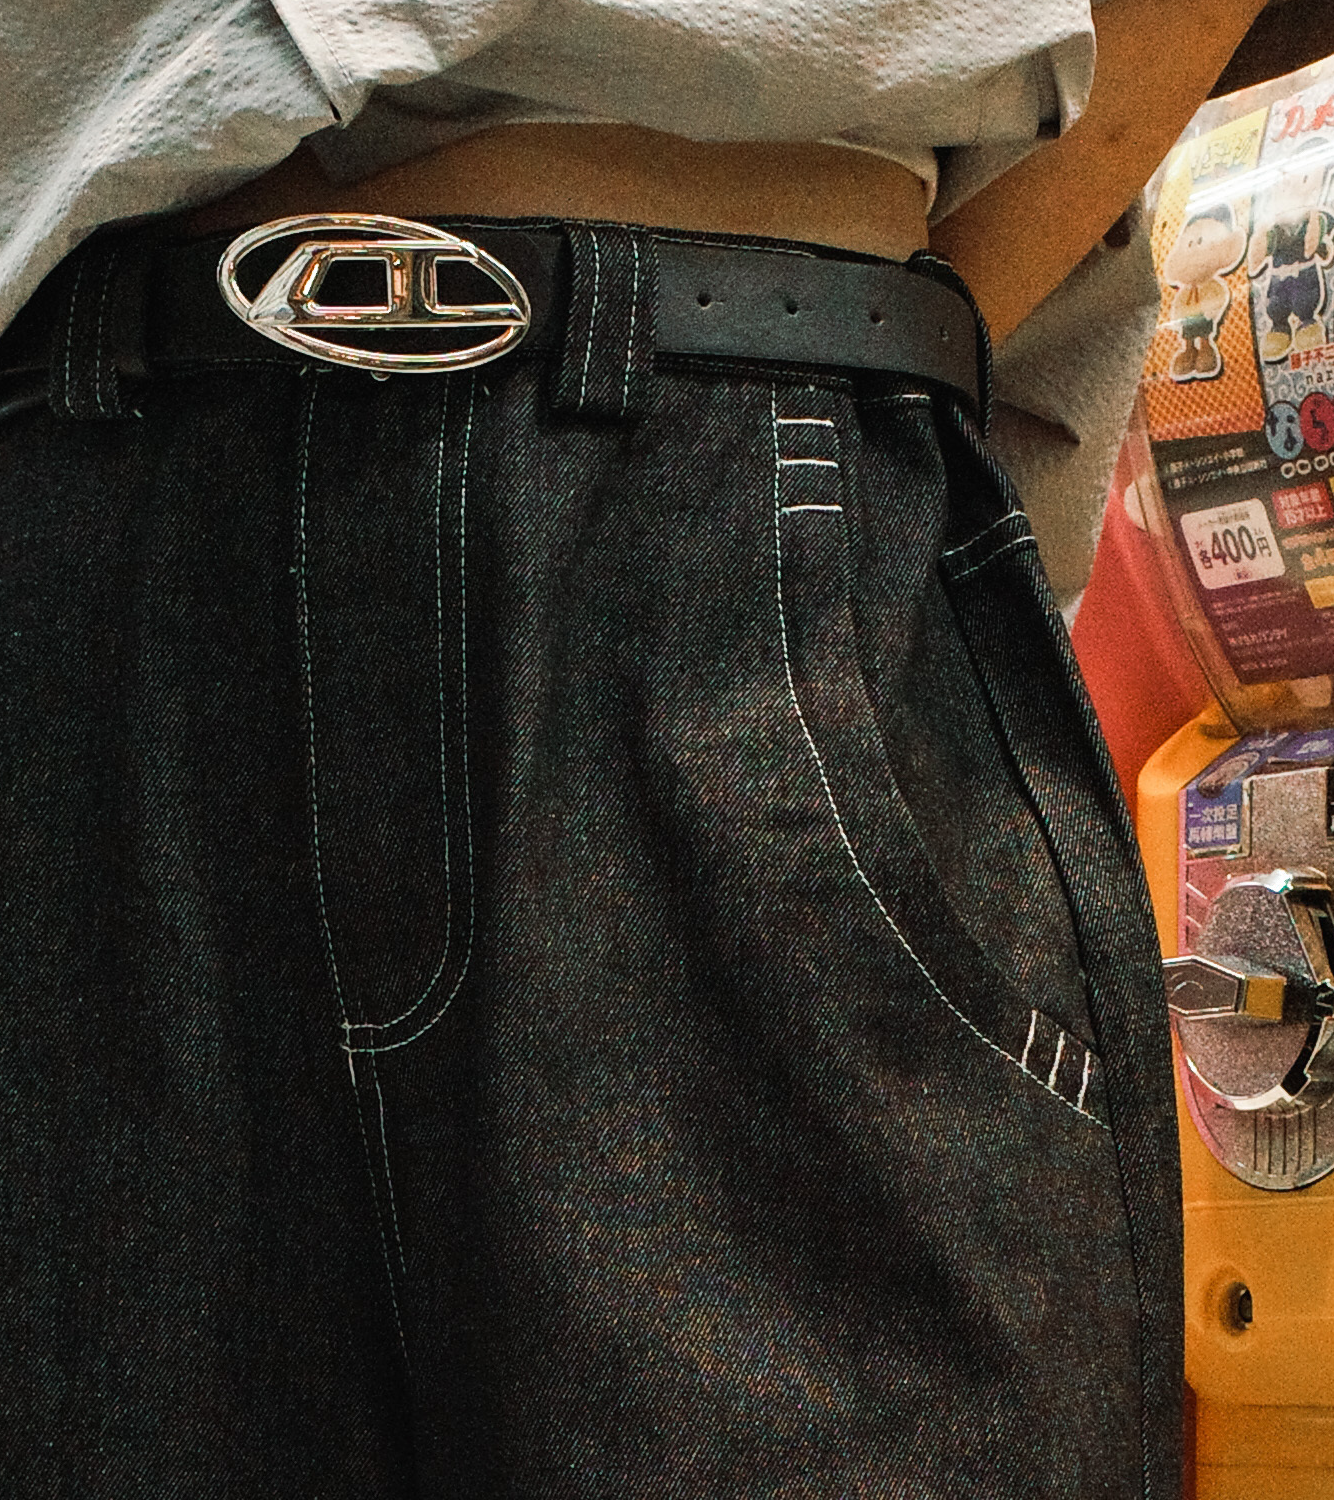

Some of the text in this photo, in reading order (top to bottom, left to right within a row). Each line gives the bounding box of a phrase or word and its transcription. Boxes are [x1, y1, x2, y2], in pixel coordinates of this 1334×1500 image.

[1200, 525, 1272, 569] 各400円
[1187, 803, 1238, 824] 一次投足
